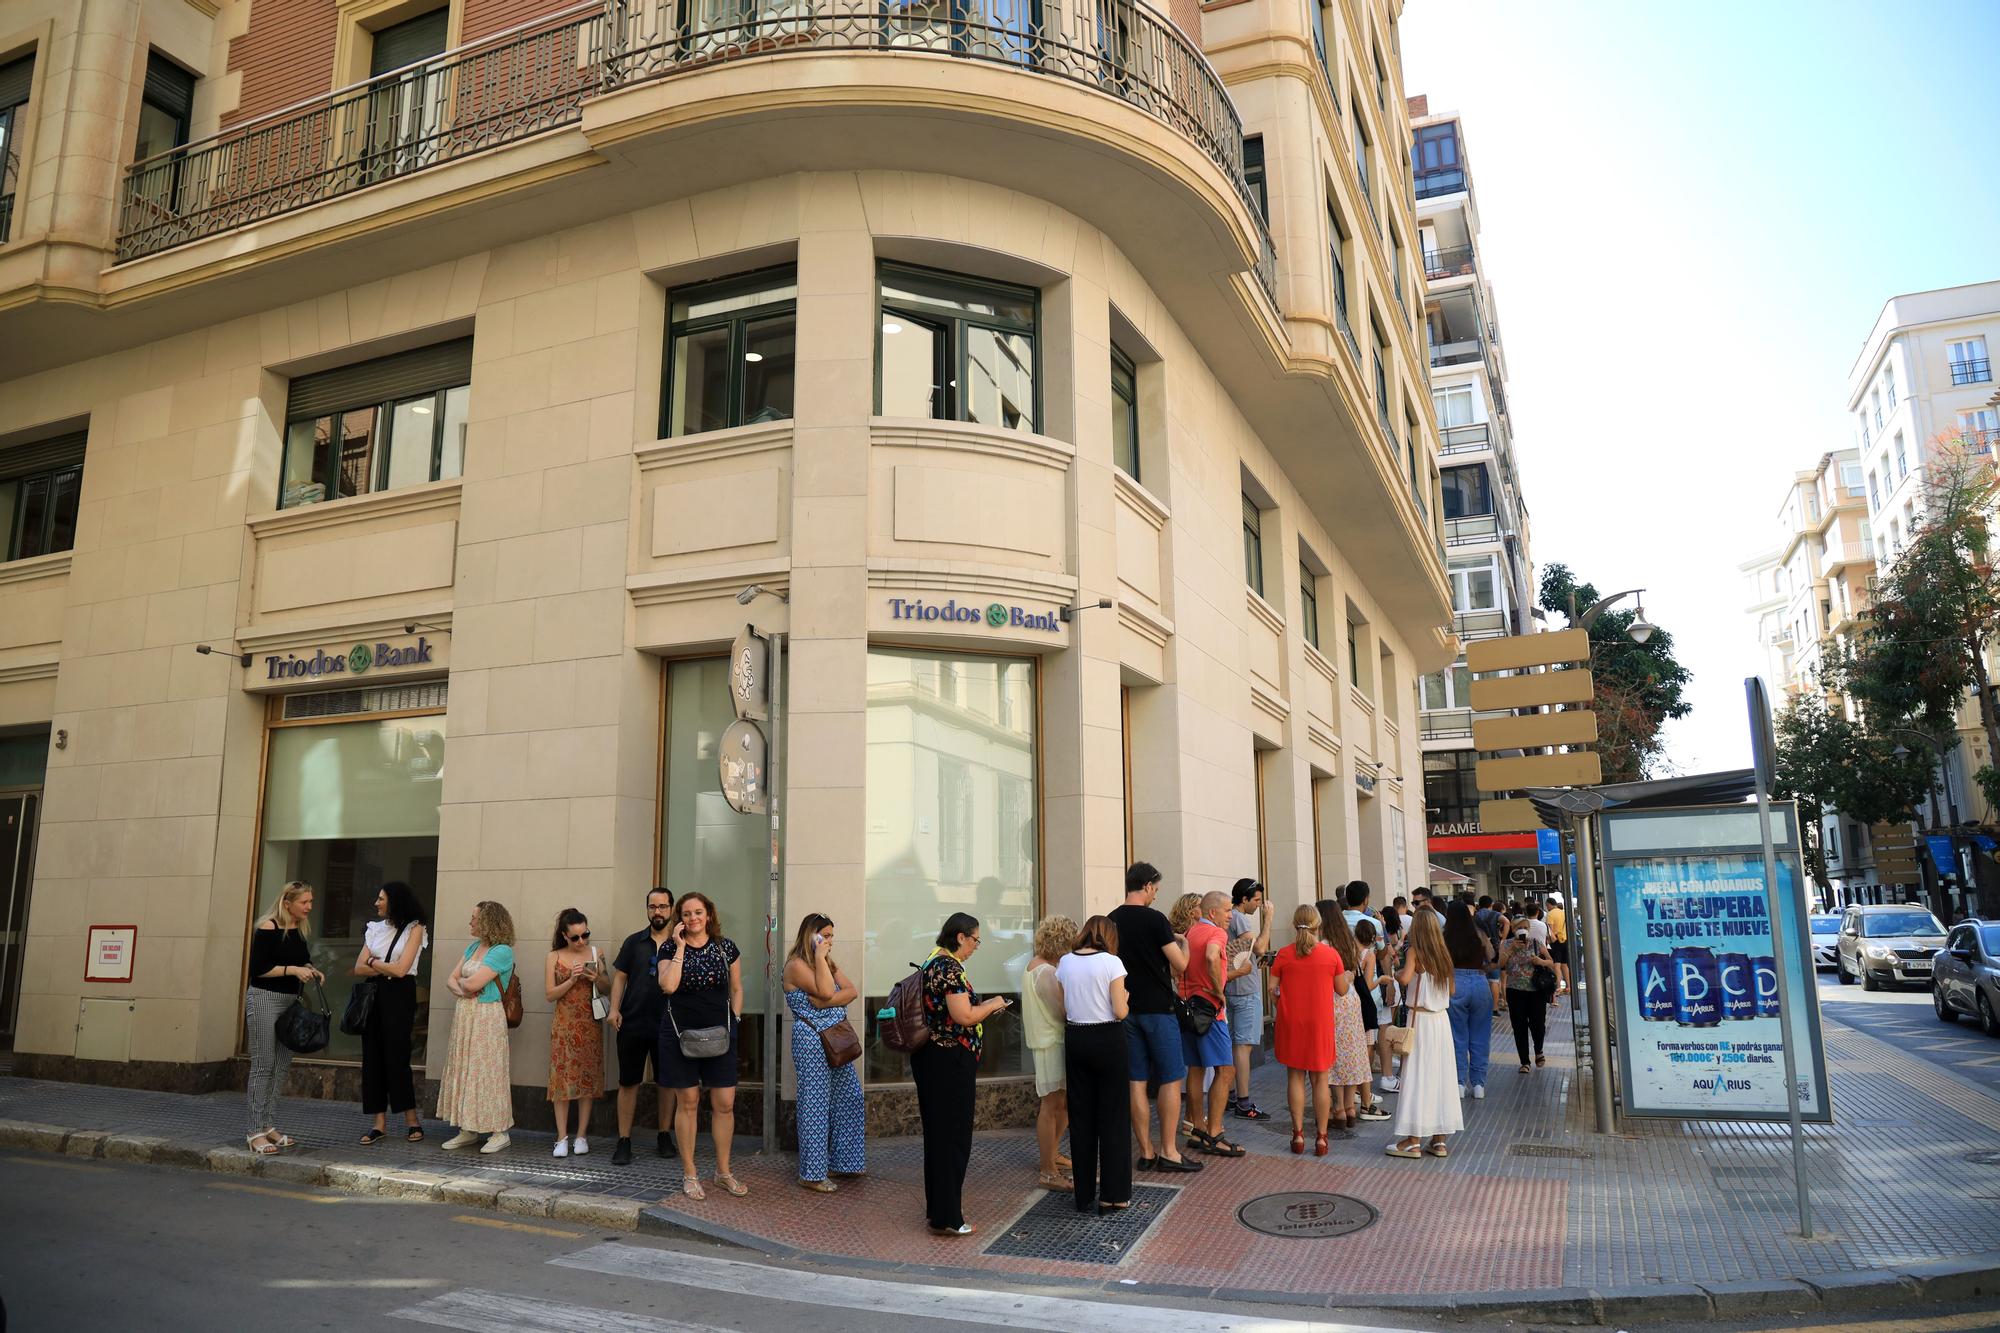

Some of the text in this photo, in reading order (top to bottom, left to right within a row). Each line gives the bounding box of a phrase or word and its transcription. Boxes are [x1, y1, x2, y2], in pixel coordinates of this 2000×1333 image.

[889, 599, 1060, 632] Triodos Bank
[265, 637, 432, 679] Triodos Bank
[55, 729, 68, 750] 3
[1680, 880, 1705, 894] CON
[1705, 879, 1763, 894] AQUARIUS
[1643, 896, 1767, 920] Y RECUPERA
[1647, 920, 1770, 940] ESO QUE TE MUEVE
[1645, 964, 1777, 1000] A B C D
[1681, 1003, 1715, 1017] AQUARIUS
[1657, 1041, 1680, 1051] Forma
[1680, 1042, 1705, 1050] verbos
[1720, 1042, 1730, 1050] RE
[1731, 1044, 1736, 1053] y
[1736, 1042, 1762, 1053] podrás
[1764, 1044, 1784, 1053] ganar
[1716, 1056, 1721, 1064] y
[1722, 1053, 1746, 1062] 250€
[1747, 1053, 1774, 1063] diarios.
[1693, 1074, 1751, 1095] AQUARIUS
[1277, 1219, 1355, 1231] Telefónica
